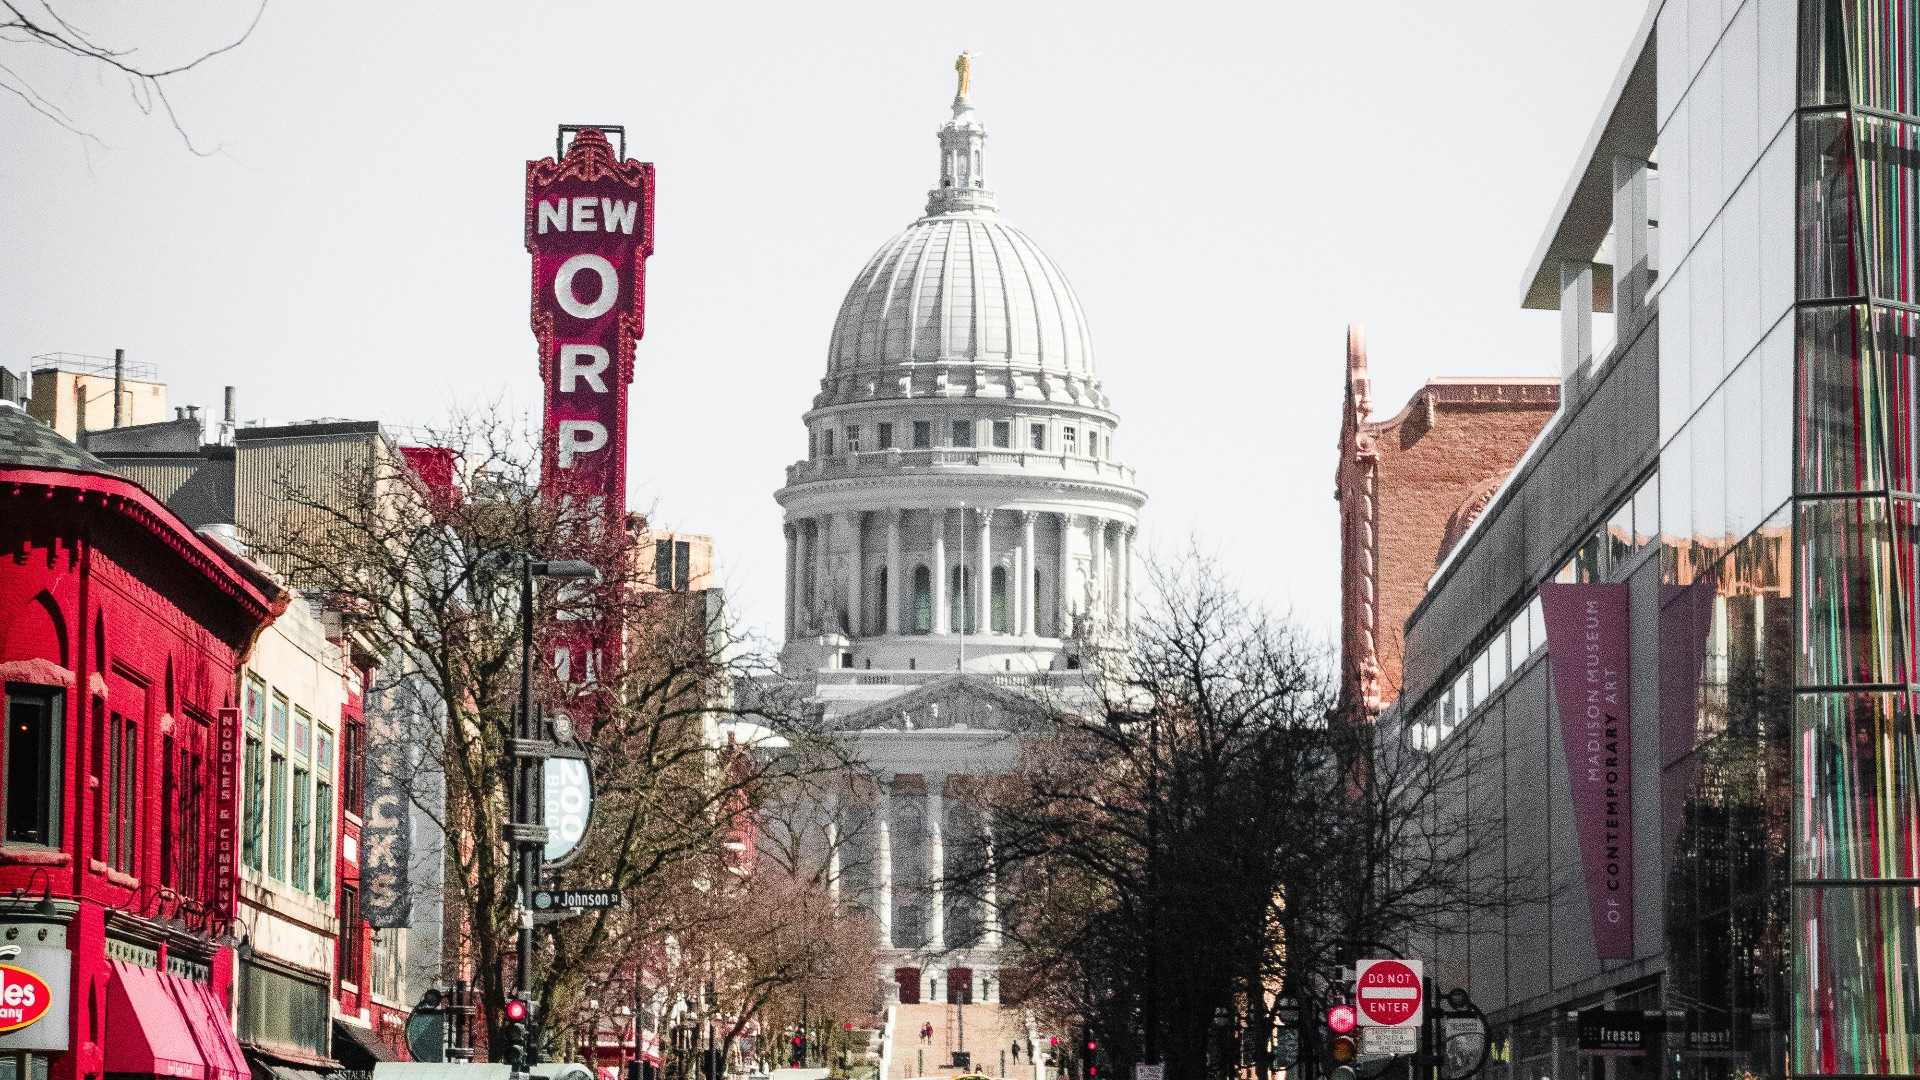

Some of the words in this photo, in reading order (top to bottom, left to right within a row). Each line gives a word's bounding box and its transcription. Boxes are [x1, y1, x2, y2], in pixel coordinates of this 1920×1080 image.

[537, 197, 638, 235] NEW
[554, 253, 619, 697] ORPHEU
[1586, 600, 1600, 683] MUSEUM
[1604, 668, 1617, 704] ART
[221, 716, 234, 800] NOODLES
[1586, 689, 1600, 782] MADISON
[560, 759, 585, 843] 200
[1605, 713, 1620, 891] CONTEMPORARY
[219, 828, 232, 911] COMPANY
[561, 891, 609, 907] Johnson
[1607, 899, 1620, 922] OF
[1368, 973, 1384, 984] DO
[1387, 973, 1411, 984] NOT
[1370, 1002, 1409, 1013] ENTER
[1600, 1026, 1641, 1042] fresco
